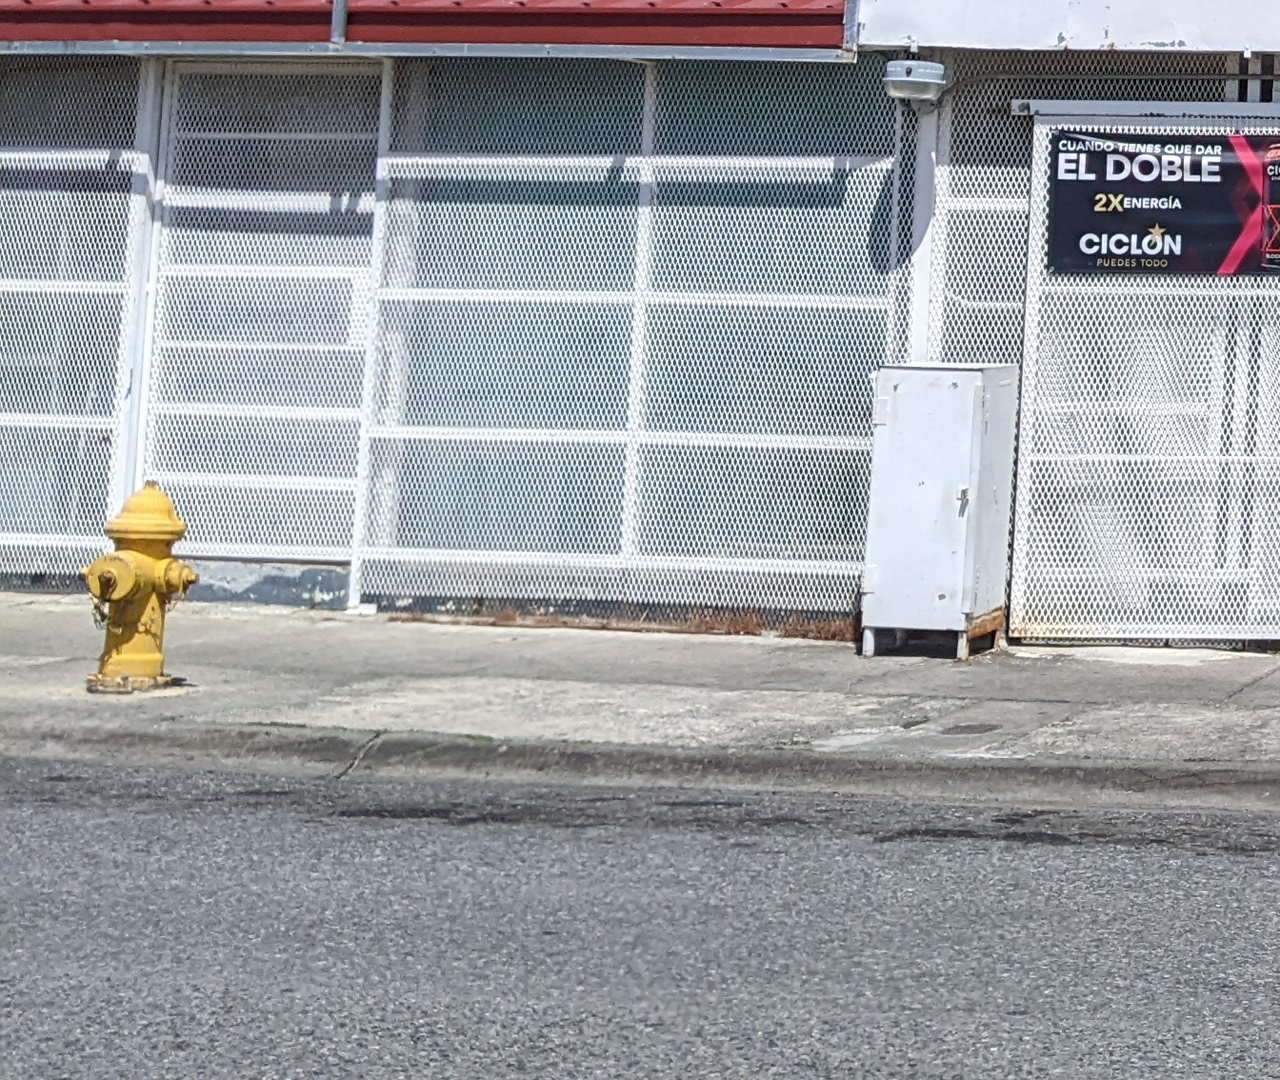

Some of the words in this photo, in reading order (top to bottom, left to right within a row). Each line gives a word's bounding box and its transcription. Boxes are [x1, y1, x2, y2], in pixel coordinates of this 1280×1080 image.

[1058, 140, 1114, 151] CUANDO
[1117, 143, 1161, 154] TIENES
[1164, 144, 1192, 155] QUE
[1195, 145, 1222, 155] DAR
[1057, 153, 1096, 181] EL
[1106, 154, 1222, 182] DOBLE
[1123, 196, 1182, 210] ENERGÍA
[1096, 258, 1137, 267] PUEDES
[1140, 258, 1168, 268] TODO
